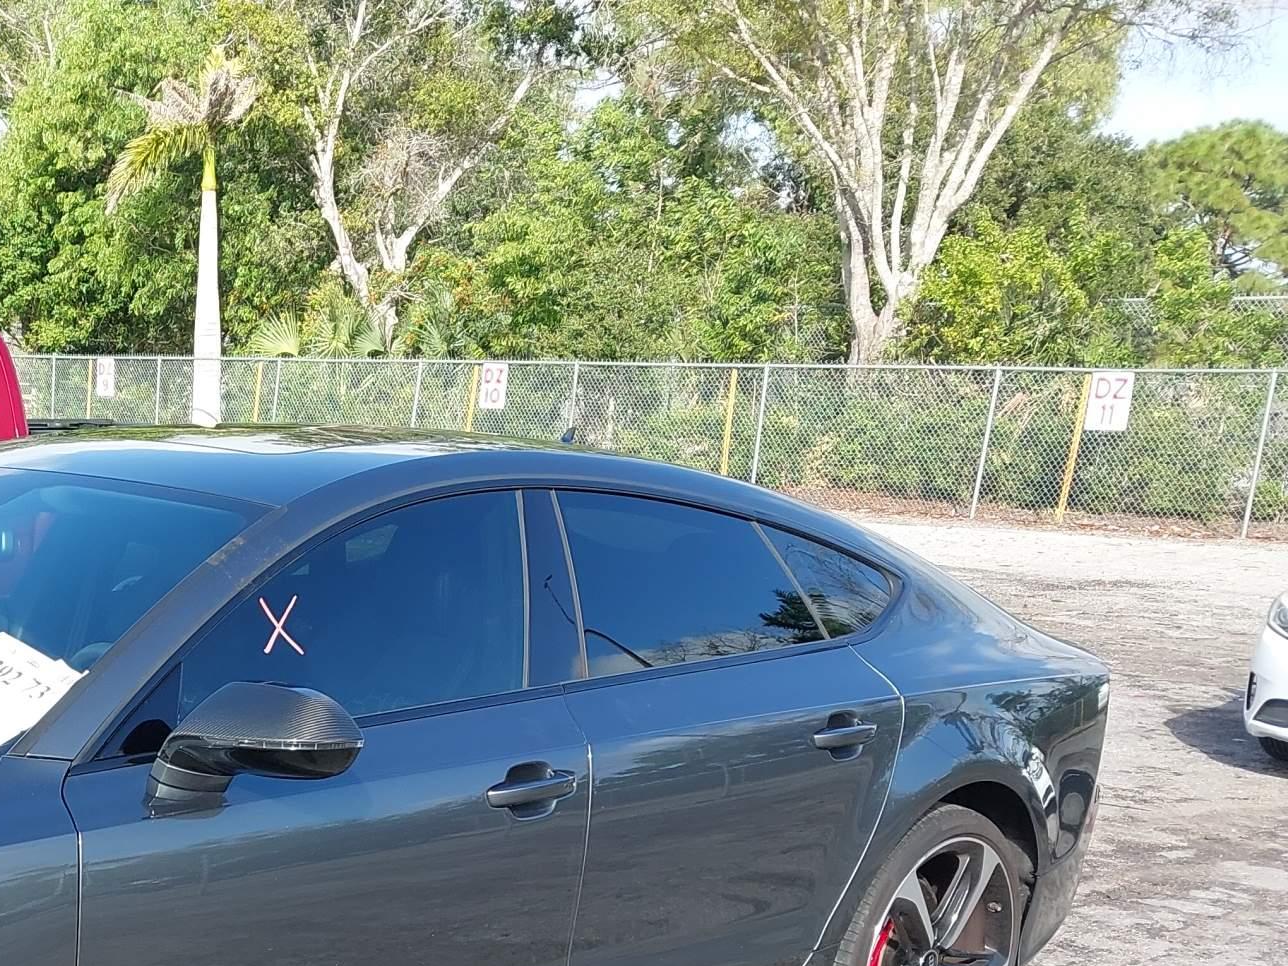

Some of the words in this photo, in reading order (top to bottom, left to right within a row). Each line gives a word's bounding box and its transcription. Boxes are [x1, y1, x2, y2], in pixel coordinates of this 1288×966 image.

[484, 368, 504, 384] DZ
[484, 388, 500, 403] 10
[1095, 377, 1128, 400] DZ
[1100, 404, 1114, 425] 11
